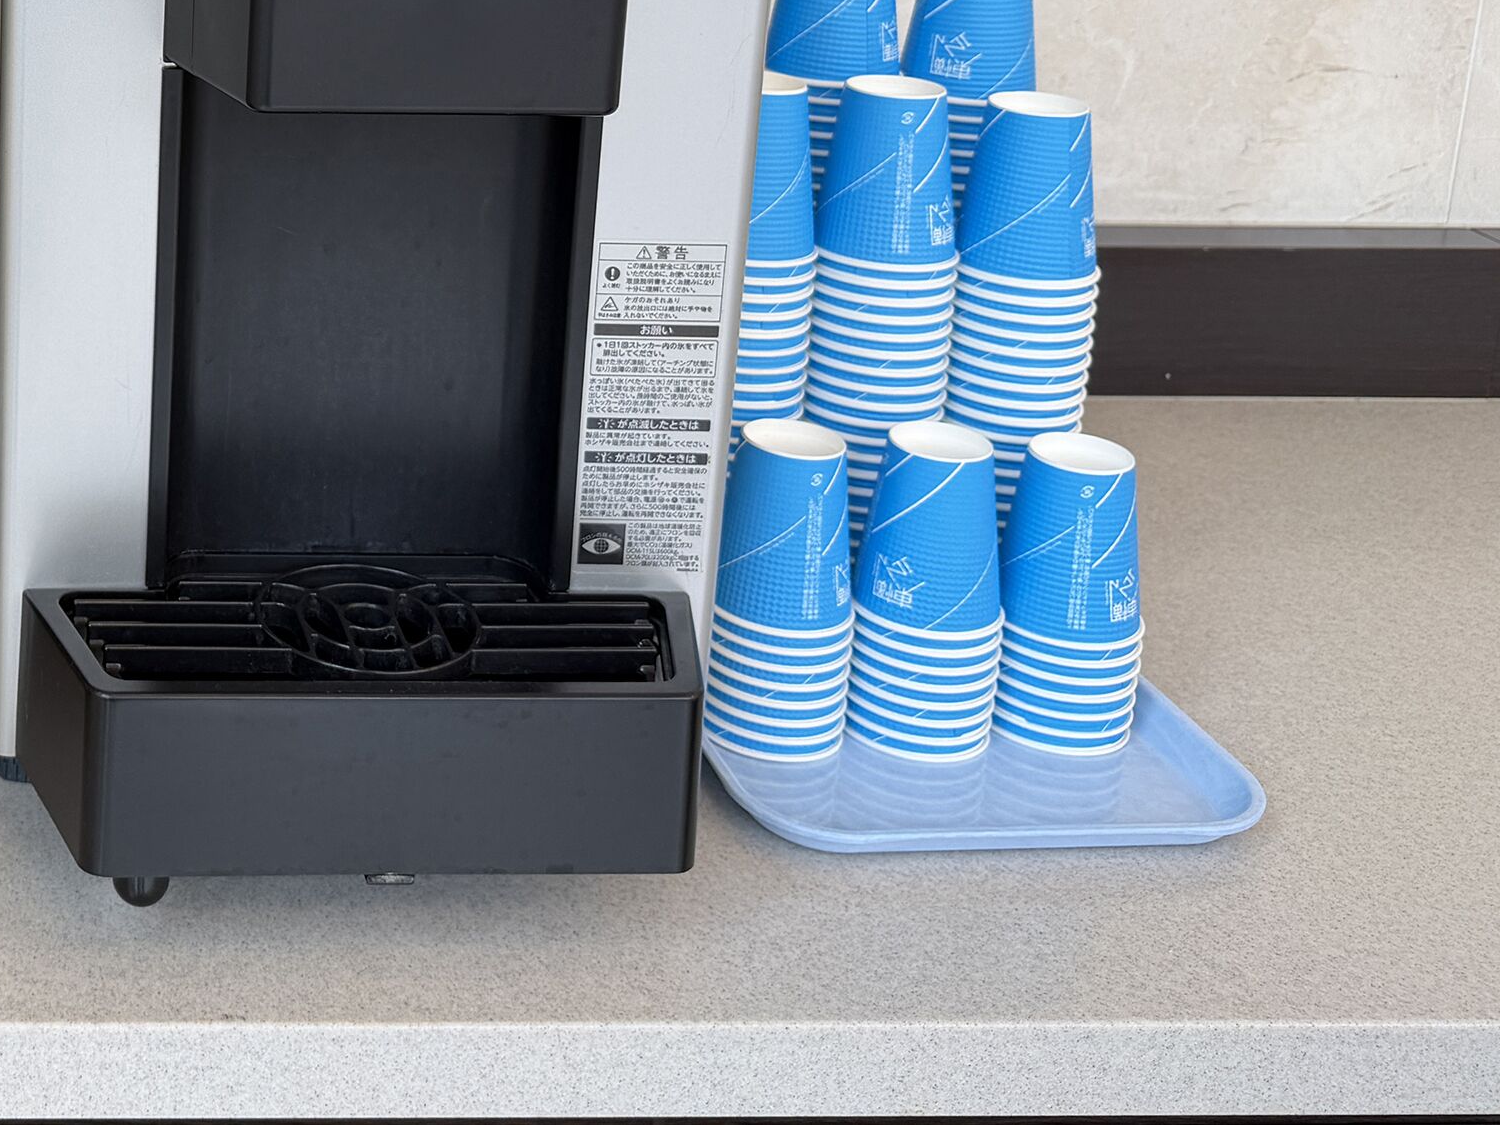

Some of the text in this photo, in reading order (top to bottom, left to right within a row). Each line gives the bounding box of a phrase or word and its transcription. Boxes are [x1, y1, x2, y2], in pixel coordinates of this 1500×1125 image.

[655, 245, 689, 261] 警告
[639, 325, 673, 335] お願い
